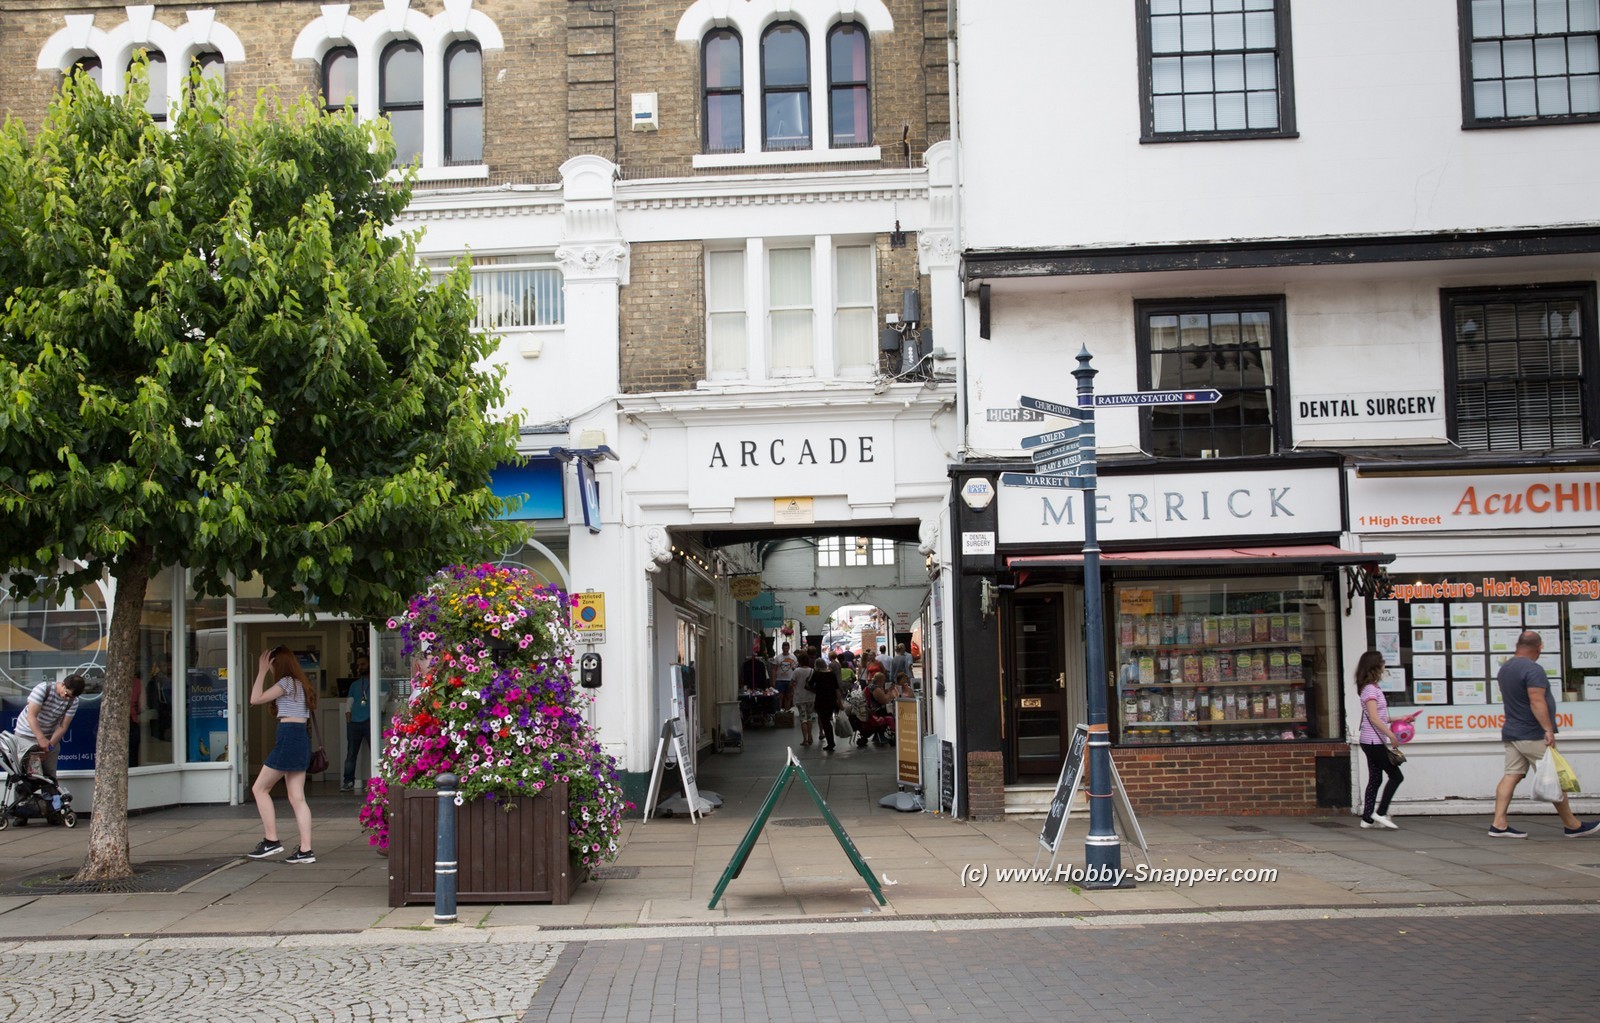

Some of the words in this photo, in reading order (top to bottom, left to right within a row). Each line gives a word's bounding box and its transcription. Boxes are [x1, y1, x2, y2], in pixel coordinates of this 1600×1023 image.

[1098, 394, 1141, 405] RAILWAY
[1141, 393, 1183, 403] STATION
[1034, 400, 1071, 415] CHURCHYARD
[1300, 399, 1359, 418] DENTAL
[1366, 396, 1436, 416] SURGERY
[990, 409, 1019, 421] HIGH
[1040, 431, 1066, 444] TOILETS
[709, 436, 874, 468] ARCADE
[1025, 476, 1063, 487] MARKET
[1041, 487, 1295, 526] MERRICK
[1359, 517, 1365, 525] 1
[1369, 515, 1399, 527] High
[1401, 514, 1441, 525] Street
[1483, 577, 1531, 598] Herbs
[1577, 651, 1598, 660] 20%
[191, 685, 212, 693] More
[1427, 715, 1464, 729] FREE
